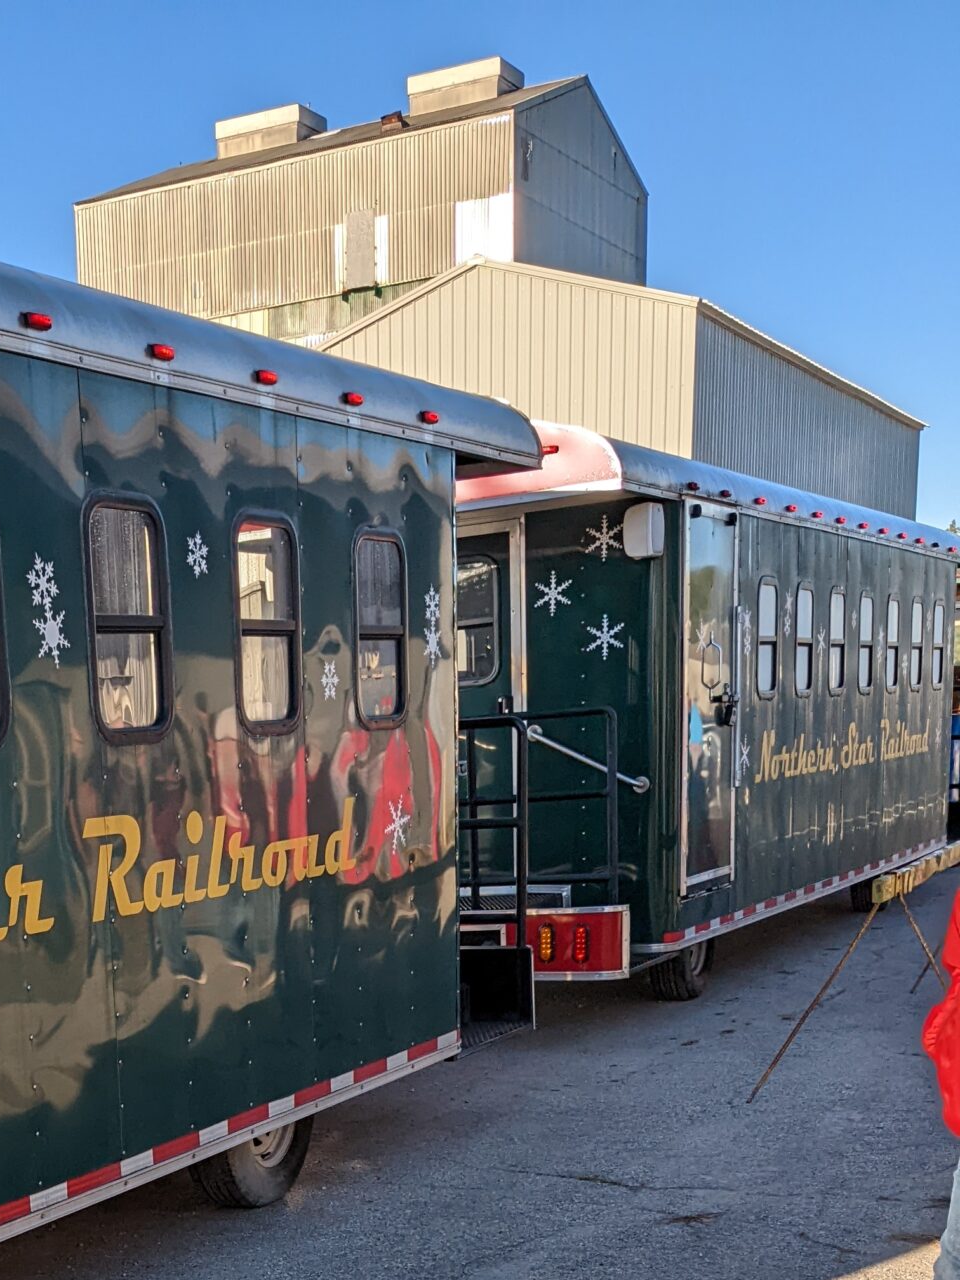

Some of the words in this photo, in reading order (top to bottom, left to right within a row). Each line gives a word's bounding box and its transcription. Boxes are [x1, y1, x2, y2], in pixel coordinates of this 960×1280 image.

[754, 729, 836, 784] Northern
[841, 721, 875, 769] Star
[880, 717, 931, 761] Railroad
[81, 793, 358, 924] Railroad
